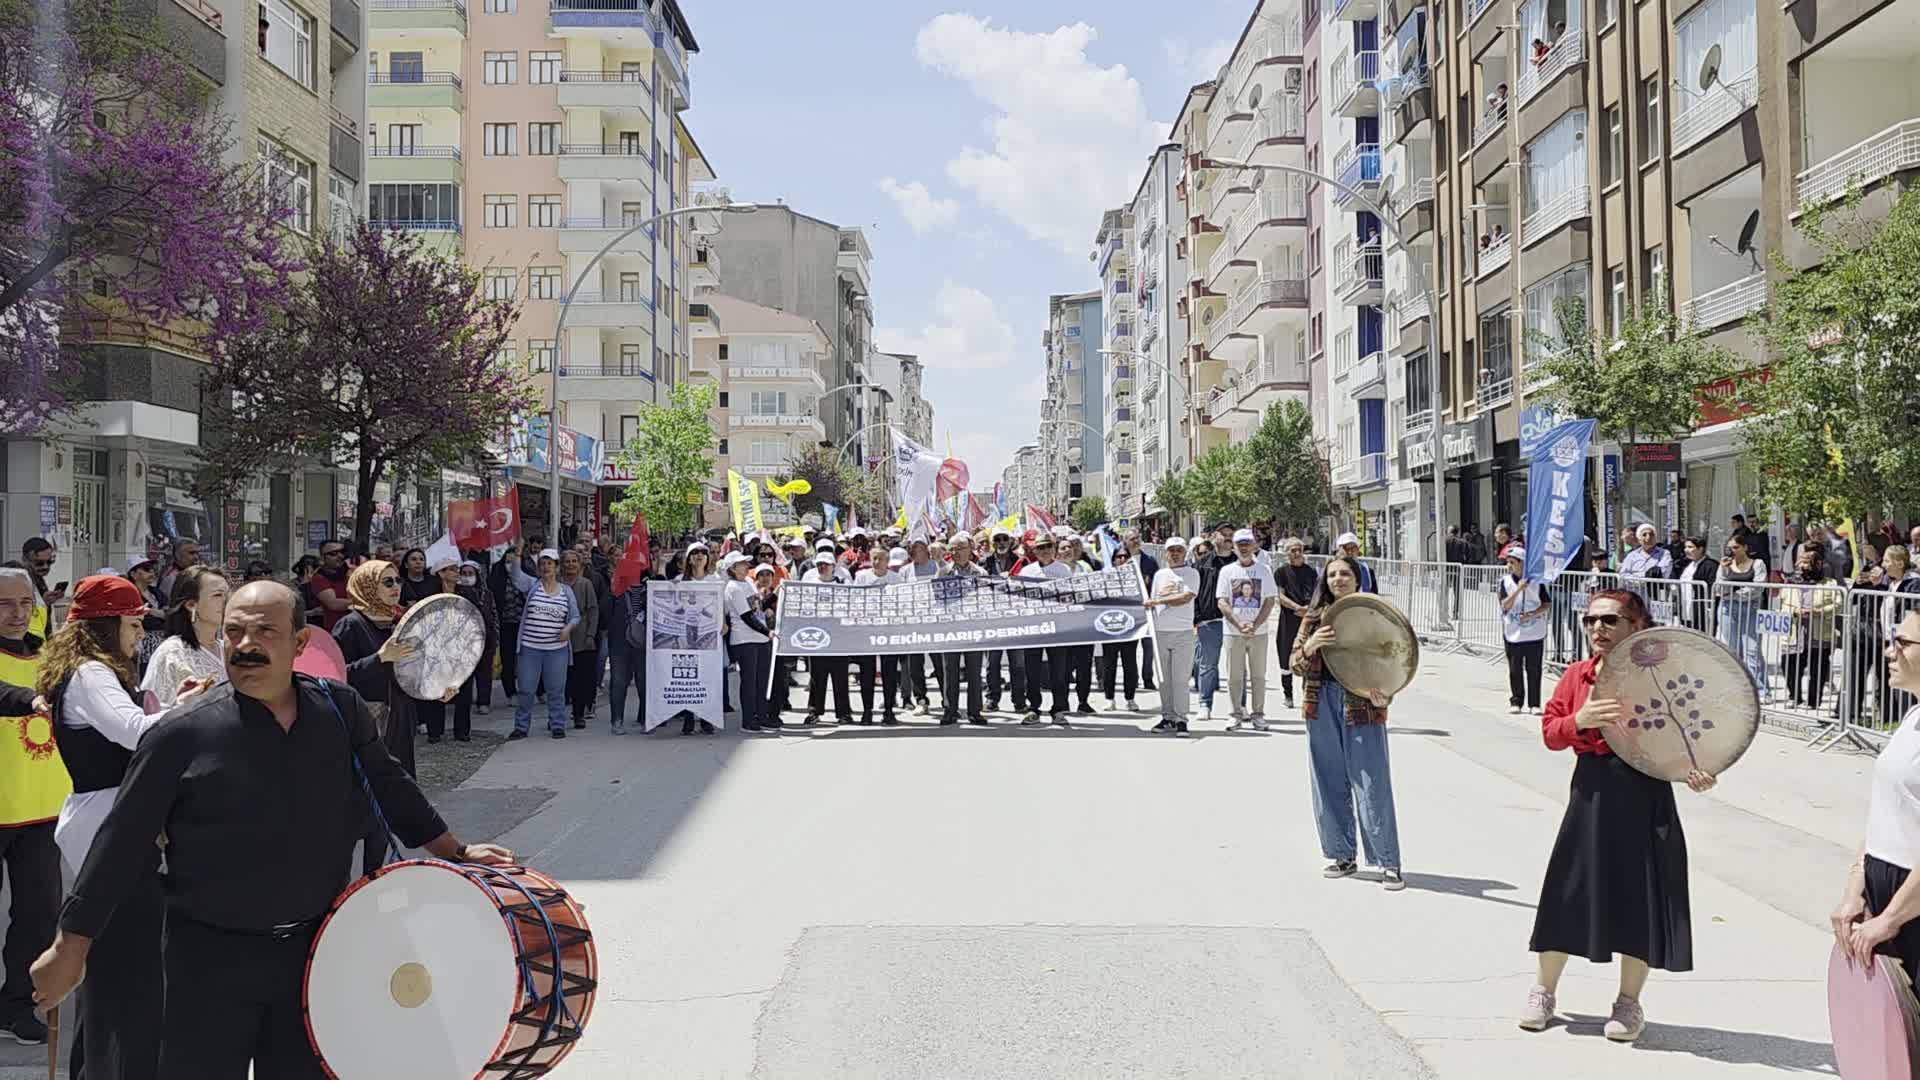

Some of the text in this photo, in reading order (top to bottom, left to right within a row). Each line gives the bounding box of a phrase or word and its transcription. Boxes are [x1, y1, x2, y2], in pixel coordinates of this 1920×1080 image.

[227, 505, 240, 570] UYKU
[1544, 470, 1571, 580] KESK
[870, 621, 1056, 646] 10 EKİM BARIŞ DERNEĞİ
[673, 667, 697, 678] BTS
